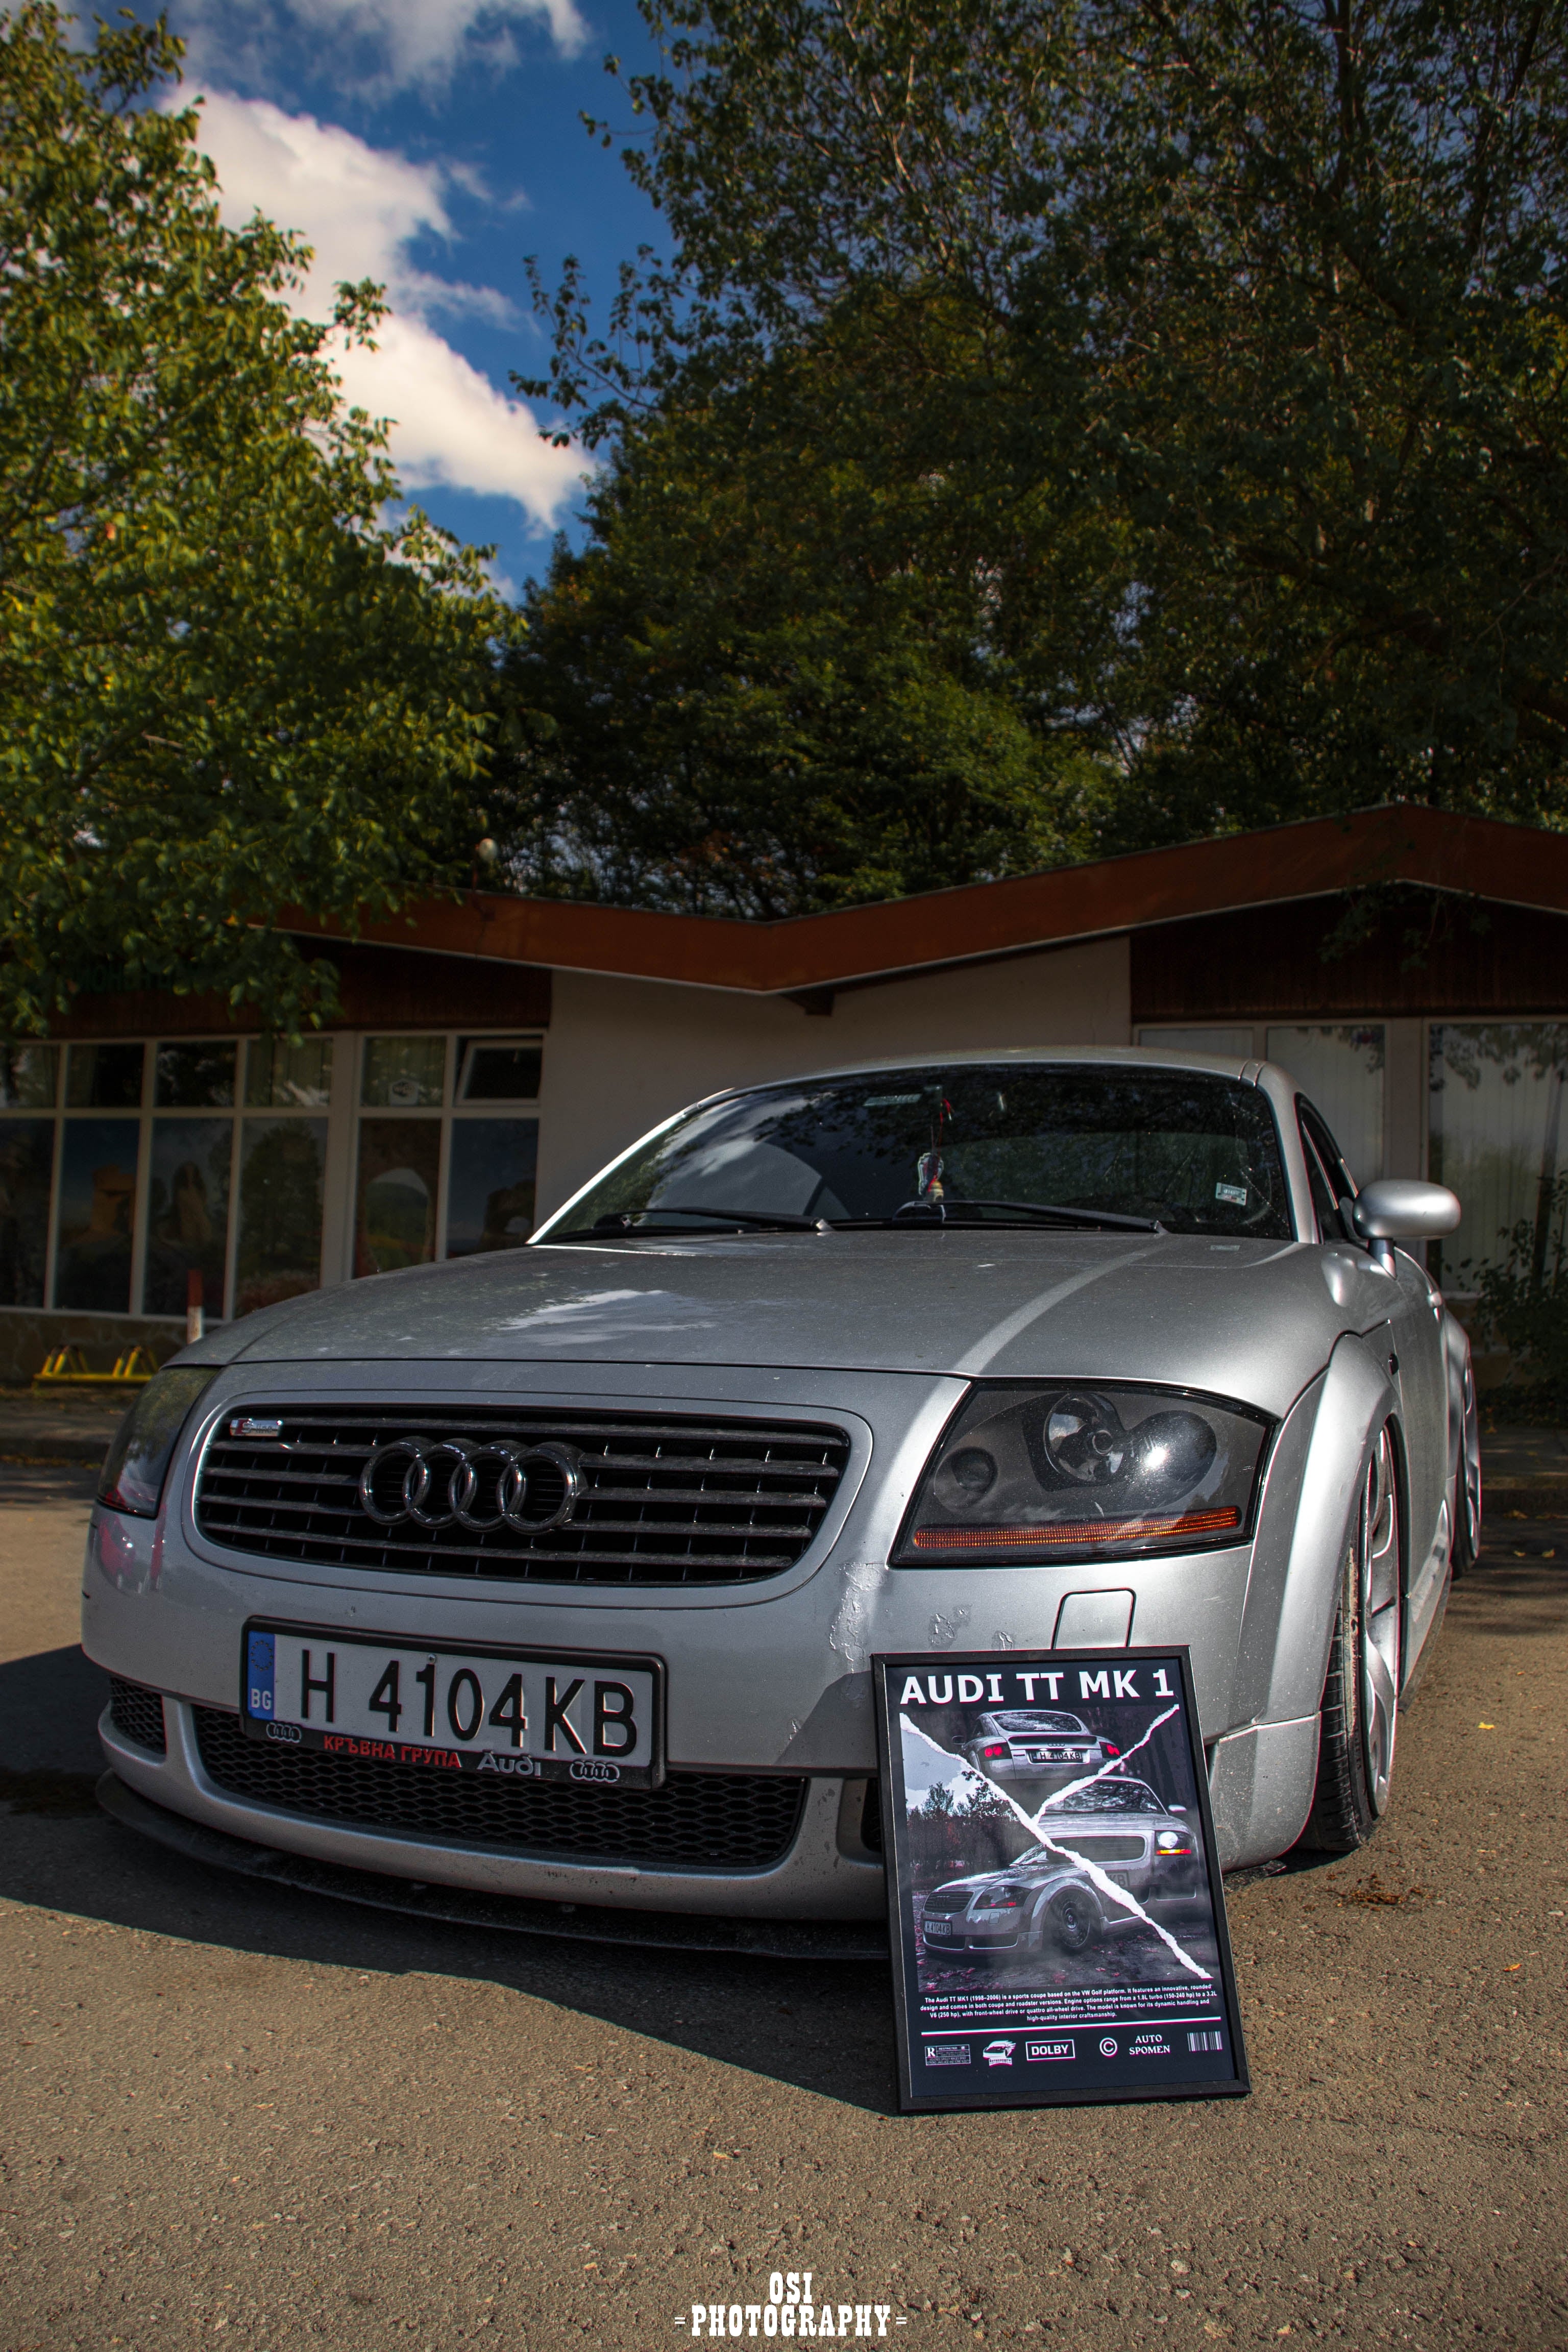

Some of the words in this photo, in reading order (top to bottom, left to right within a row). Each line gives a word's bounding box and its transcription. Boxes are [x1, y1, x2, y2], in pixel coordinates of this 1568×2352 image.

[301, 1649, 335, 1723] H
[900, 1674, 1004, 1704] AUDI
[1016, 1672, 1064, 1701] TT
[1079, 1670, 1140, 1699] MK
[1153, 1669, 1174, 1697] 1
[250, 1688, 272, 1710] BG
[323, 1735, 395, 1760] КРЪВНА
[401, 1746, 461, 1768] ГРУПА
[477, 1751, 541, 1776] Audi
[1032, 2045, 1068, 2055] DOLBY
[1129, 2045, 1170, 2055] SPOMEN
[1135, 2035, 1162, 2044] AUTO
[927, 2047, 936, 2057] R
